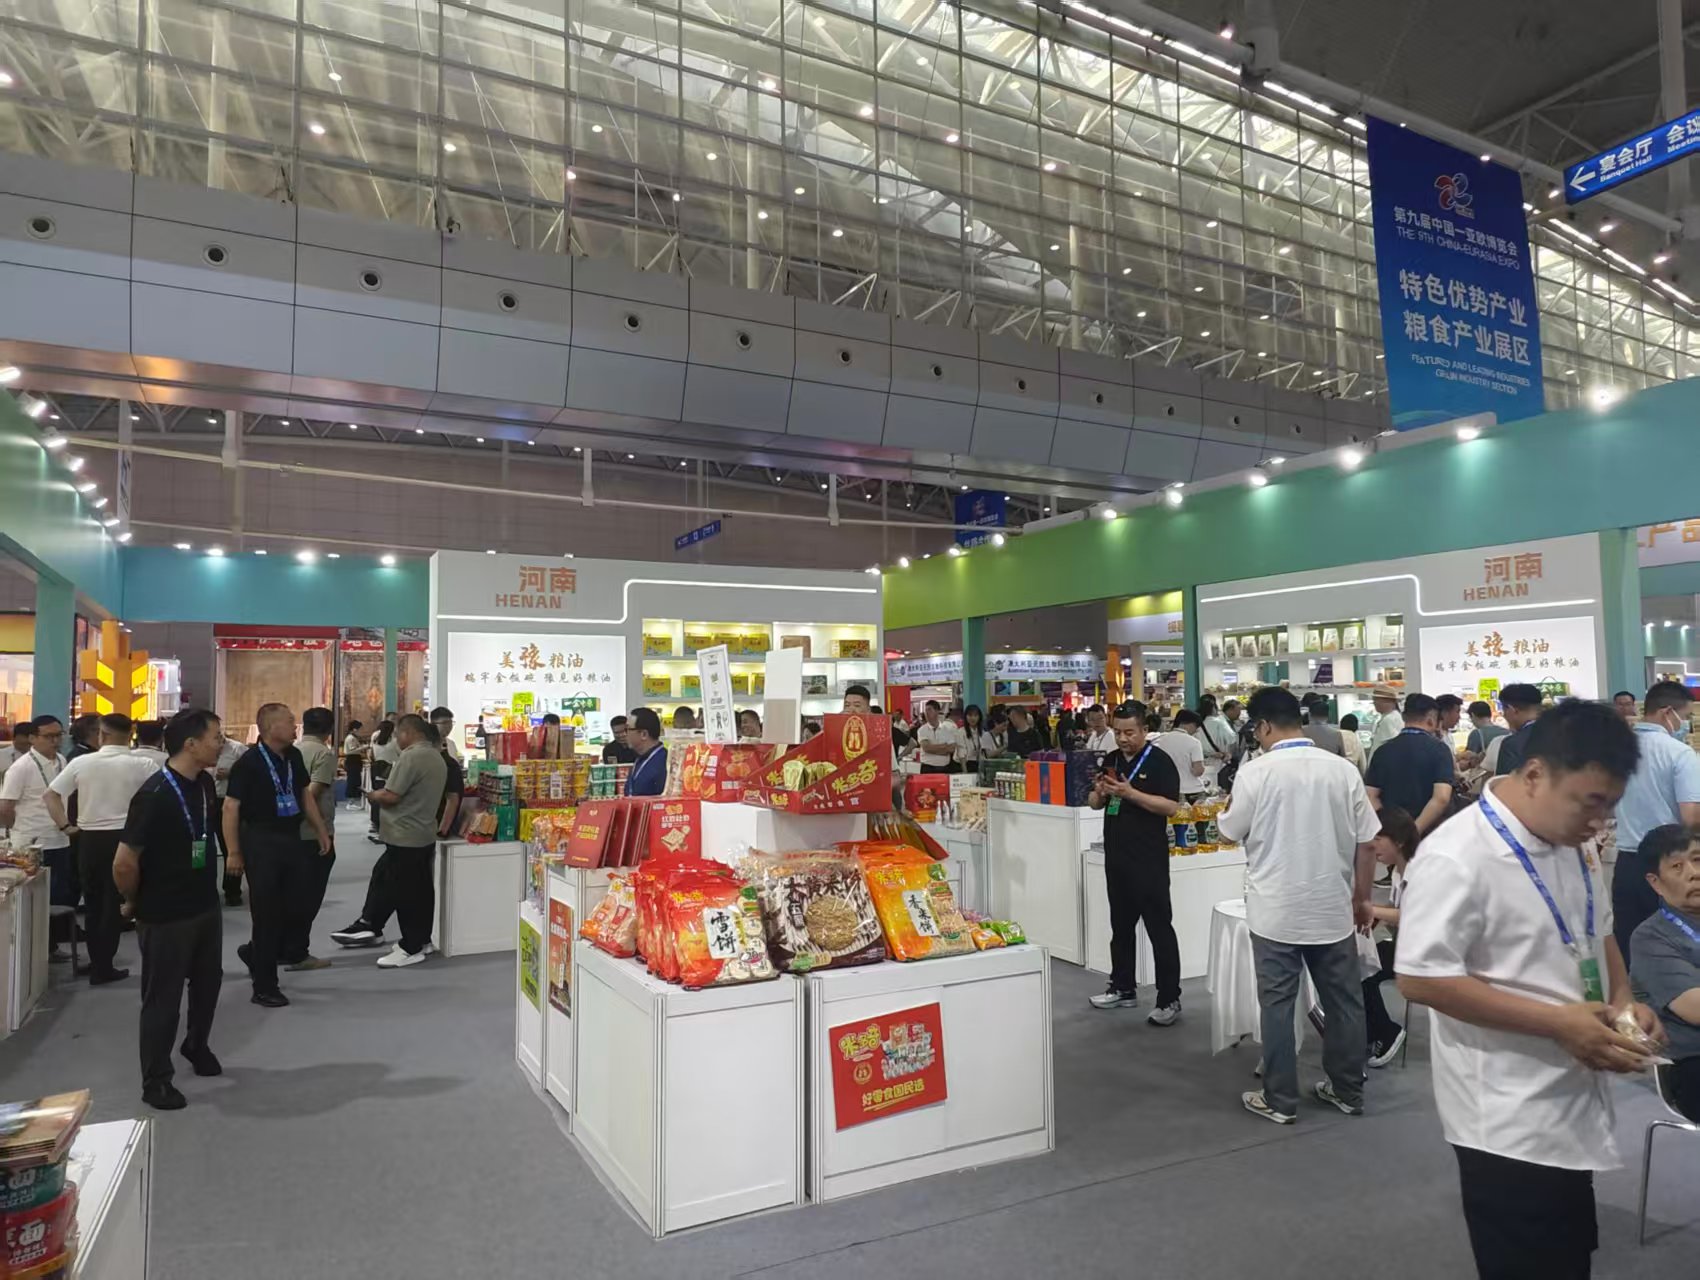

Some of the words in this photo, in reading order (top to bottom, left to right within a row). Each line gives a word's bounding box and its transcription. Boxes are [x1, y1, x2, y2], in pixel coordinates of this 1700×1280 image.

[1599, 138, 1652, 175] 宴会厅
[1397, 226, 1416, 240] THE
[1399, 269, 1528, 327] 特色优势产业
[1403, 310, 1531, 366] 粮食产业展区
[519, 565, 577, 594] 河南
[1484, 552, 1543, 584] 河南
[496, 594, 562, 609] HENAN
[1463, 583, 1529, 601] HENAN
[500, 643, 584, 671] 美豫粮油
[1464, 631, 1550, 657] 美豫粮油
[709, 910, 739, 955] 雪饼
